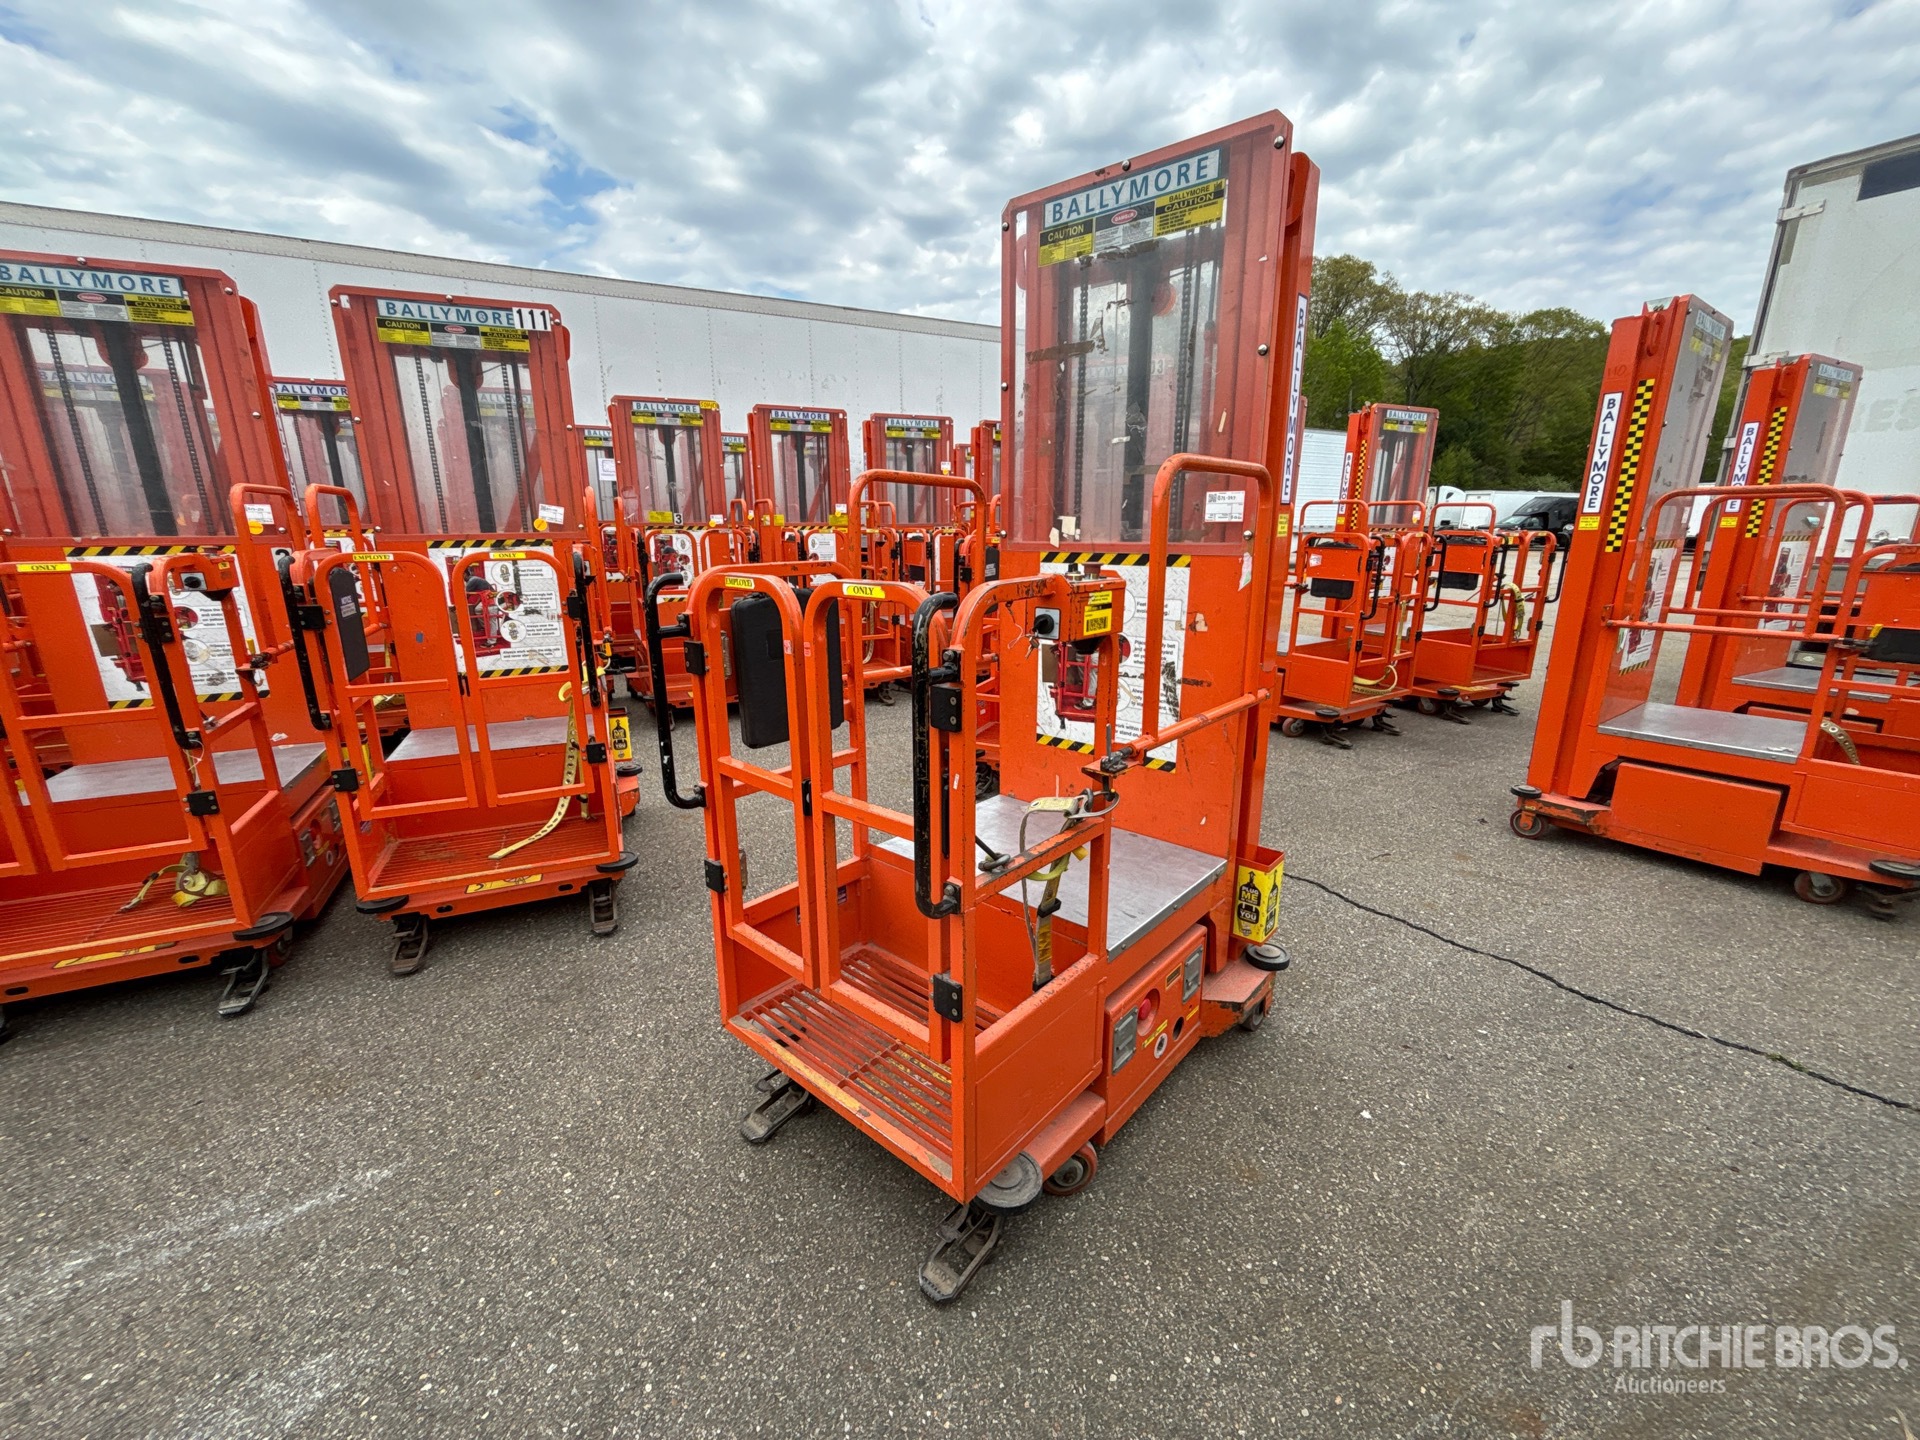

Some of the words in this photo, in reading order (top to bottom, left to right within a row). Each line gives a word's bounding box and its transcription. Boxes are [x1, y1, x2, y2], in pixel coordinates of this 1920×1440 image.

[1052, 155, 1209, 223] BALLYMORE
[1168, 185, 1210, 203] BALLYMORE
[1164, 192, 1214, 212] CAUTION
[1047, 224, 1085, 242] CAUTION
[0, 265, 172, 294] BALLYMORE
[0, 287, 45, 298] CAUTION
[134, 301, 182, 310] CAUTION
[385, 301, 515, 326] BALLYMORE
[385, 320, 421, 330] CAUTION
[516, 308, 548, 331] 111
[274, 385, 348, 396] BALLYMOR
[636, 402, 698, 413] BALLYMORE
[1283, 308, 1305, 497] BALLYMORE
[774, 410, 828, 420] BALLYMORE
[1388, 411, 1427, 420] BALLYMORE
[890, 419, 937, 428] BALLYMORE
[1587, 398, 1617, 509] BALLYMORE
[675, 514, 682, 525] 3
[852, 585, 875, 596] ONLY
[1241, 890, 1260, 901] ME
[1240, 910, 1257, 921] YOU
